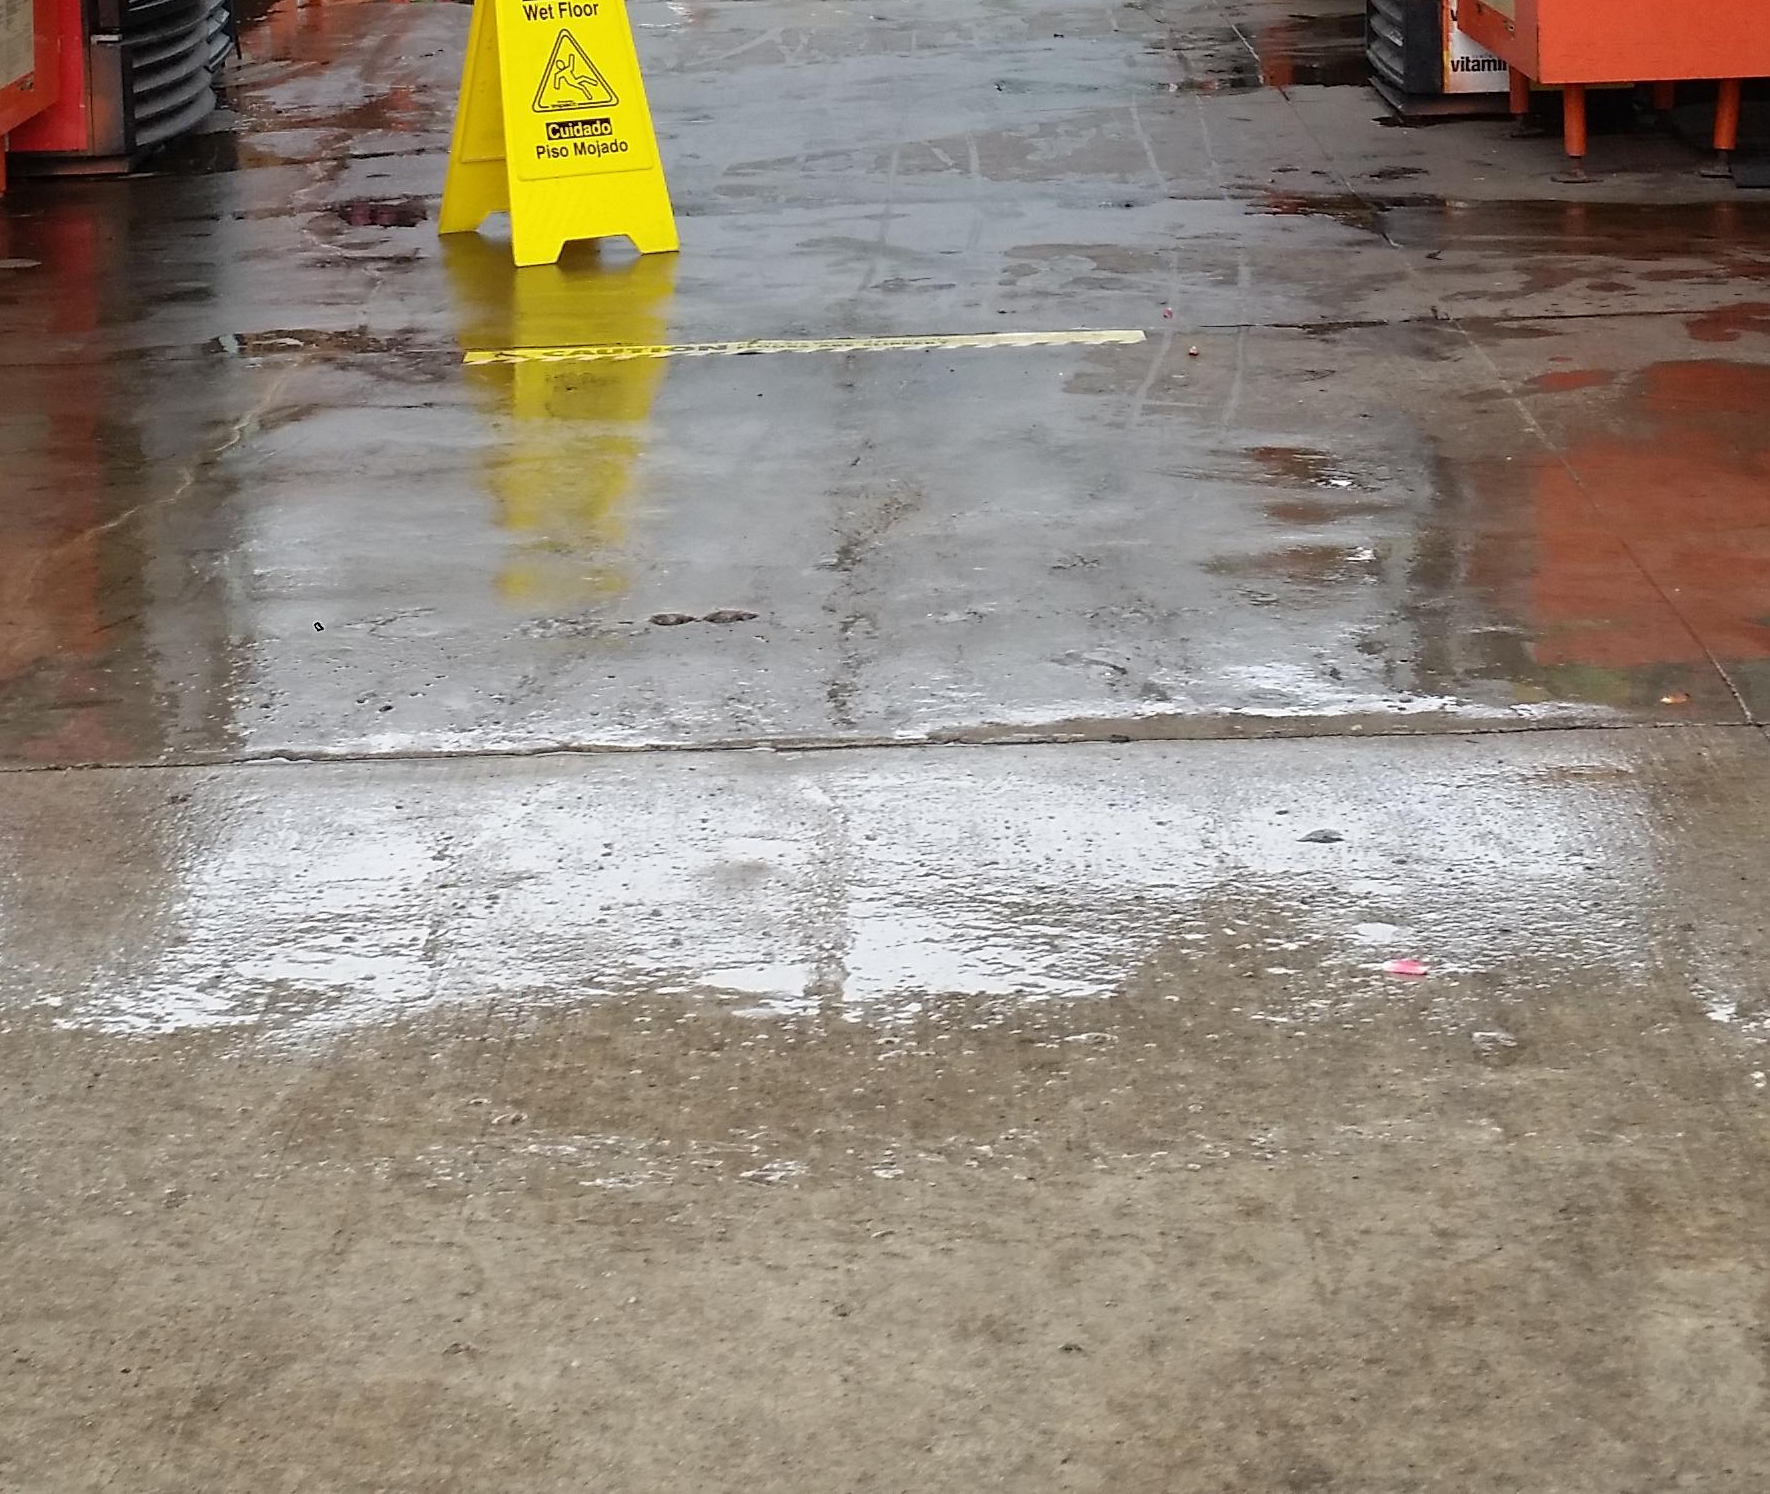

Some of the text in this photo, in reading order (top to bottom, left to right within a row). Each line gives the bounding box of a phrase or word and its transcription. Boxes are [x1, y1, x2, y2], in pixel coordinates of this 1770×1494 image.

[523, 2, 599, 21] Wet Floor
[546, 120, 612, 139] Cuidado
[537, 138, 629, 159] Piso Mojado
[542, 344, 728, 357] CAUTION
